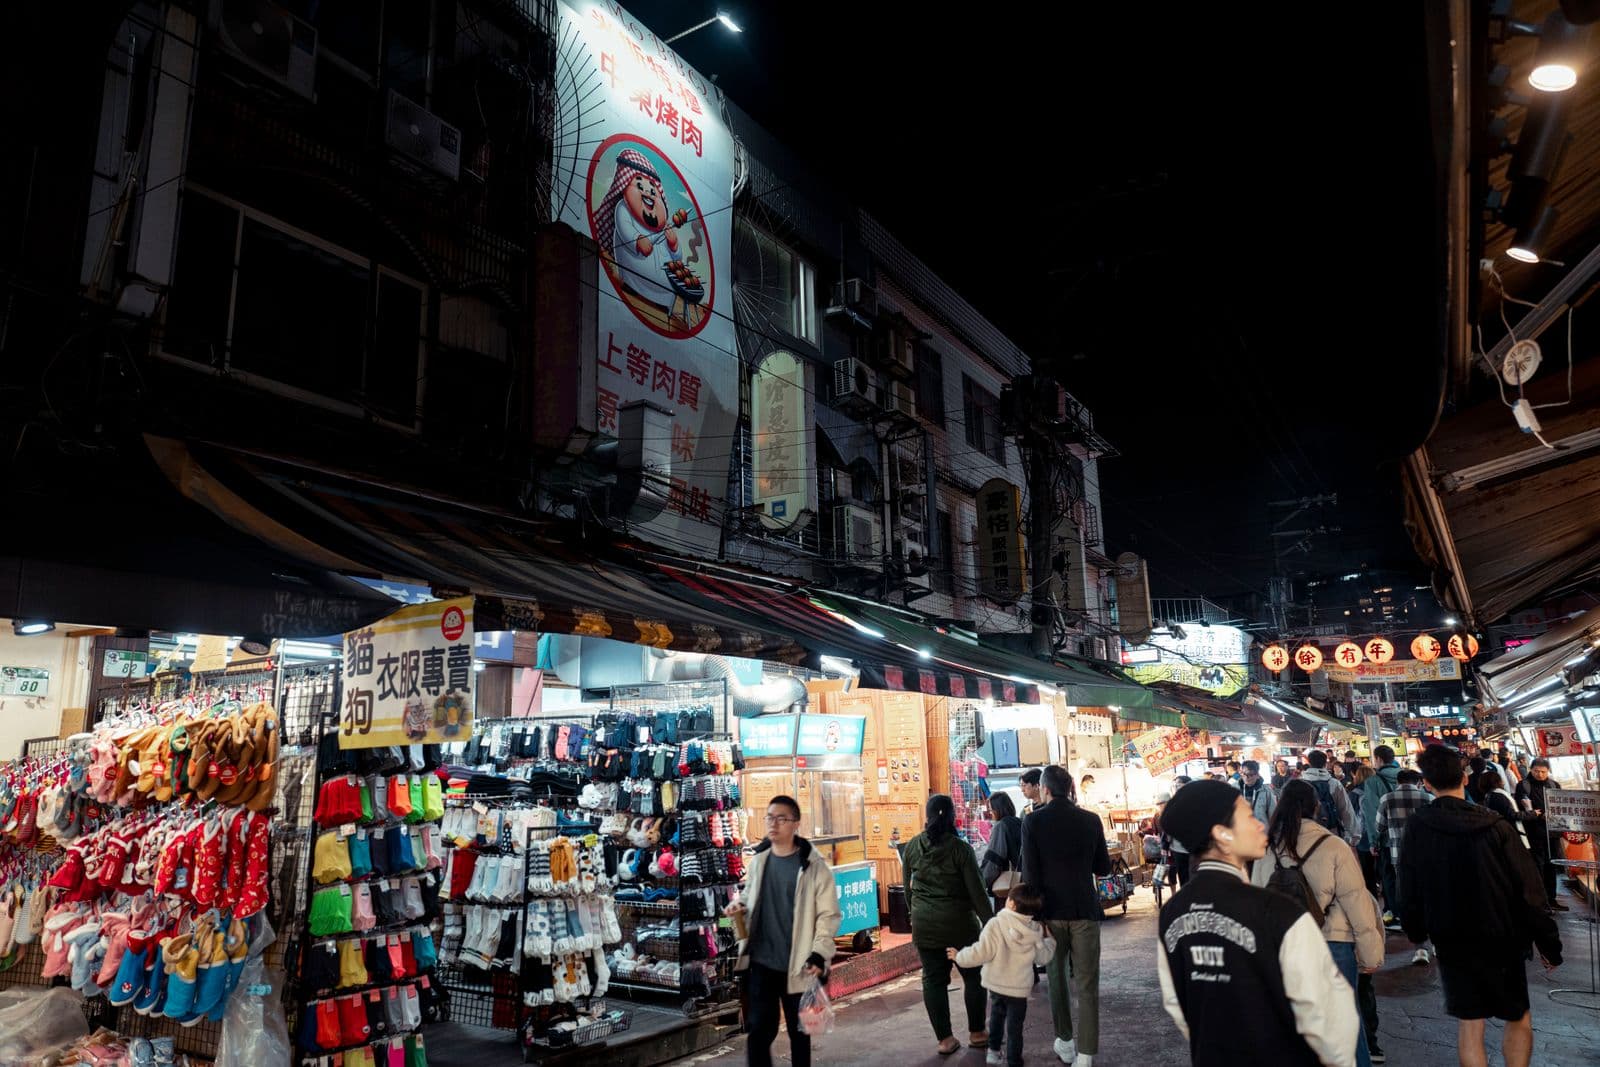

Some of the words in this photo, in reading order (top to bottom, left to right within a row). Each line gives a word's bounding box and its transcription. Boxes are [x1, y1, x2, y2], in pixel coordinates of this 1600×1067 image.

[597, 333, 702, 411] 上等肉質
[1299, 651, 1317, 666] 餘
[1341, 647, 1356, 663] 有
[1370, 643, 1386, 659] 年
[122, 664, 138, 674] 82
[377, 644, 473, 701] 衣服專賣
[20, 681, 38, 692] 80
[344, 628, 375, 736] 貓狗
[844, 880, 873, 898] 中東烤肉
